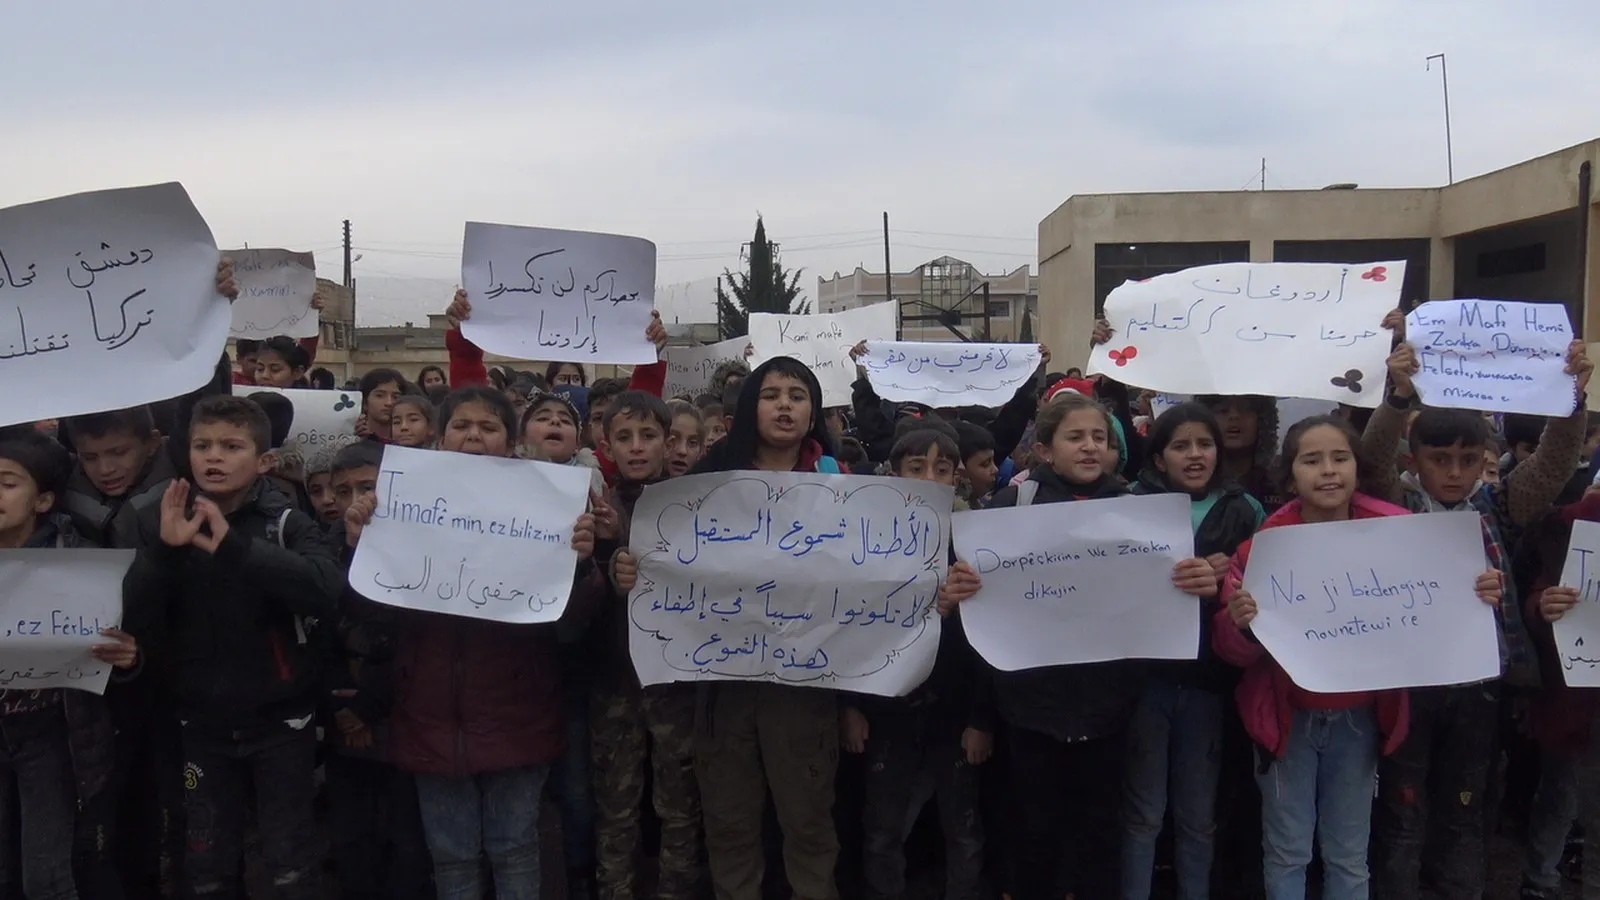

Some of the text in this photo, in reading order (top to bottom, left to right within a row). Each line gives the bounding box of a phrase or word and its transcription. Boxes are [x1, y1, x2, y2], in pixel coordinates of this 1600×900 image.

[67, 240, 154, 289] دمشق
[551, 266, 577, 298] لن
[1192, 268, 1349, 303] أردوغان
[86, 288, 155, 351] تركيا
[537, 308, 598, 354] إرادتنا
[867, 349, 906, 374] حقي
[907, 356, 931, 375] من
[994, 347, 1013, 370] لا
[489, 521, 506, 536] ez
[677, 508, 930, 565] الأطفال شموع المستقبل
[1118, 541, 1172, 556] Zarokan
[437, 558, 467, 600] أن
[467, 580, 525, 609] حقي
[1270, 570, 1307, 608] Na
[1322, 577, 1339, 614] ji
[528, 594, 558, 612] من
[651, 582, 707, 621] إطفاء
[711, 587, 743, 622] في
[832, 575, 917, 625] تكونوا
[901, 594, 925, 628] لا
[17, 620, 42, 635] ez
[1400, 615, 1420, 628] re
[773, 649, 829, 669] هذه
